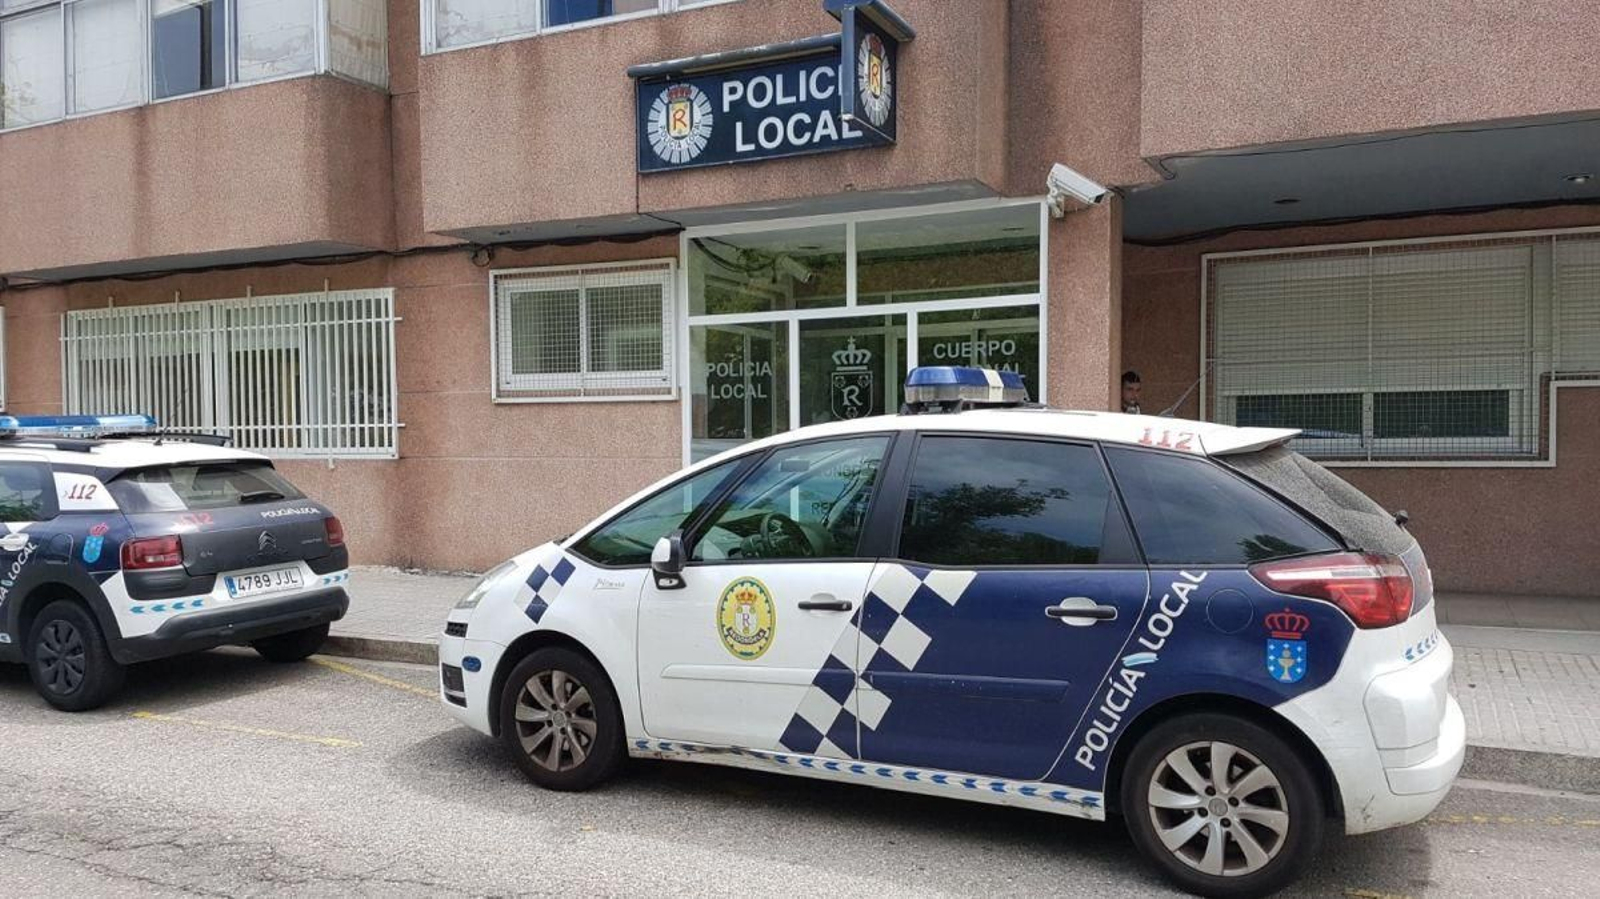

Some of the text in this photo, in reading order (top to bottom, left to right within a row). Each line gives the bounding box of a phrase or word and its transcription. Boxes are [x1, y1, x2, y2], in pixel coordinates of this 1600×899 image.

[735, 110, 863, 152] LOCAL
[933, 339, 1017, 359] CUERPO
[705, 361, 773, 378] POLICIA
[711, 383, 768, 399] LOCAL
[1138, 427, 1194, 450] 112
[67, 483, 98, 500] 112
[8, 542, 38, 580] LOCAL
[238, 570, 299, 592] 4789 JJL
[1075, 570, 1207, 771] POLICÍA LOCAL
